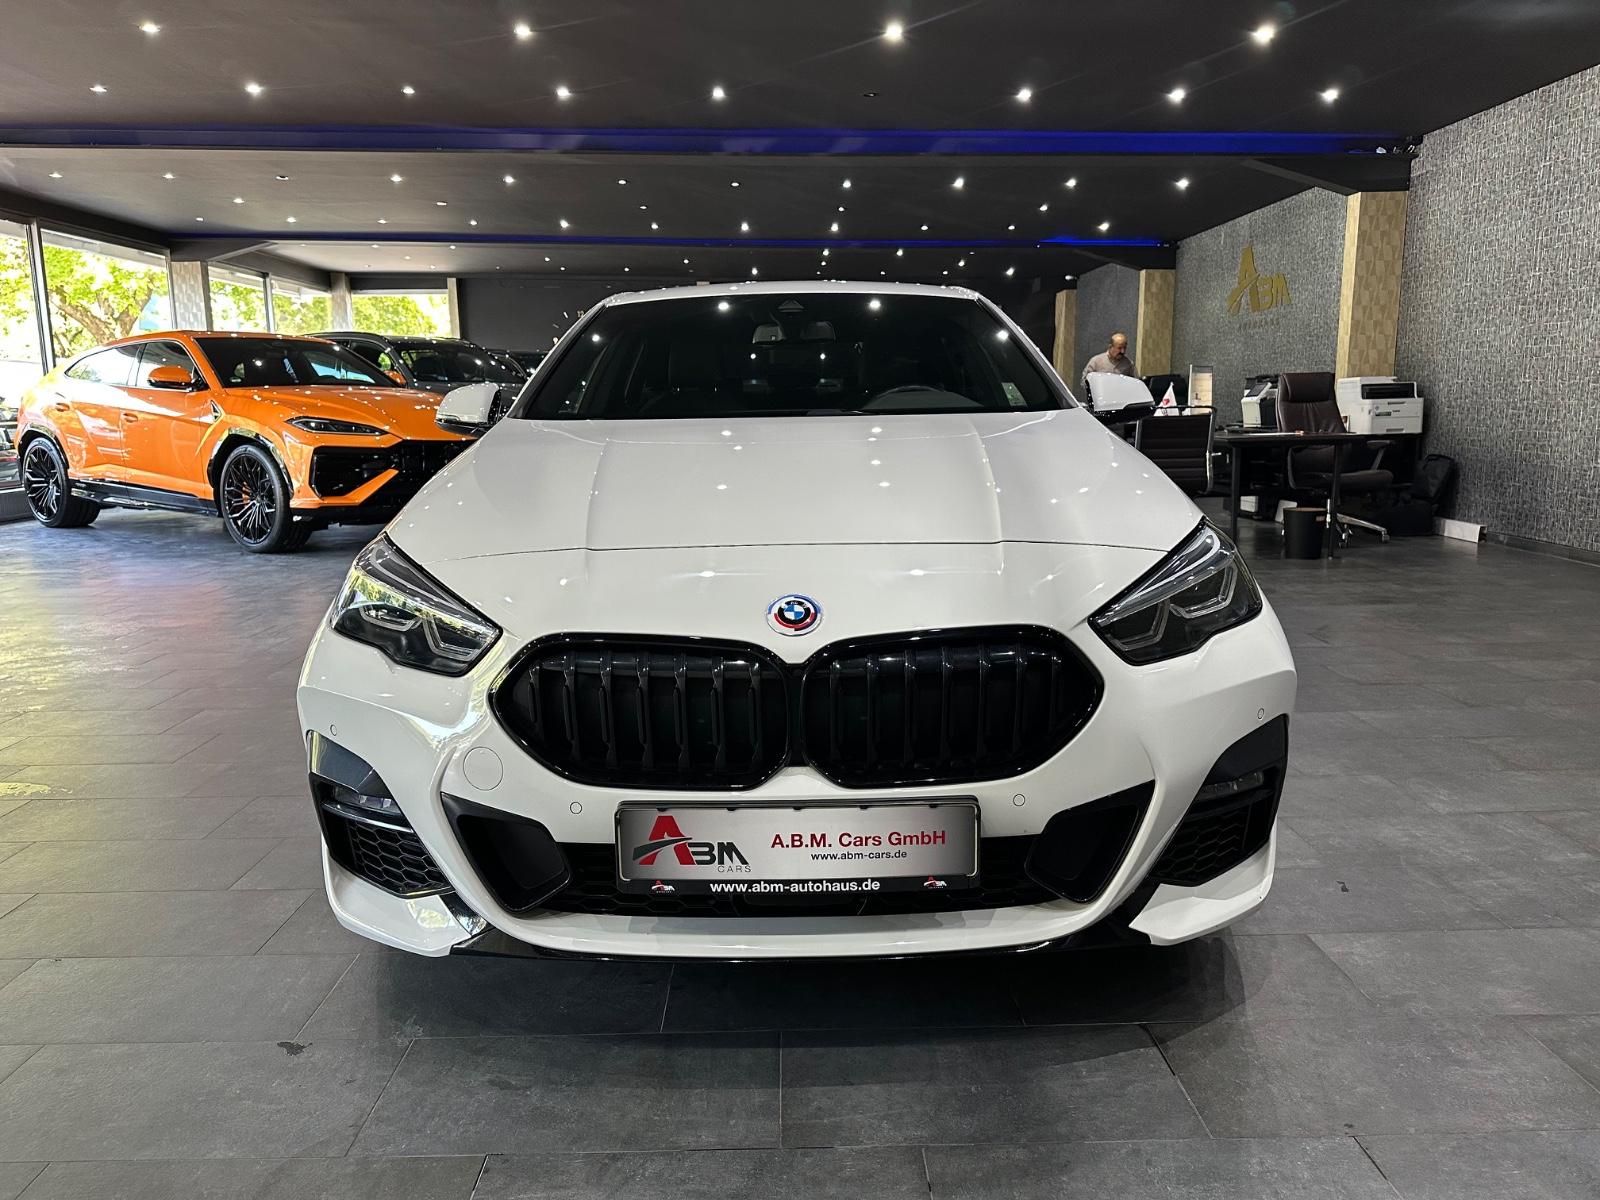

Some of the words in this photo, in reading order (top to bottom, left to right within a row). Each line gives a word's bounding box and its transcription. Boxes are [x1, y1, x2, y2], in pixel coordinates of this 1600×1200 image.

[1226, 244, 1292, 316] ABM
[632, 815, 750, 865] ABM
[771, 833, 832, 848] A.B.M.
[838, 832, 882, 847] Cars
[888, 830, 946, 846] GmbH
[810, 849, 907, 860] www.abm-cars.de
[717, 865, 752, 873] CARS
[710, 879, 880, 893] www.abm-autohaus.de
